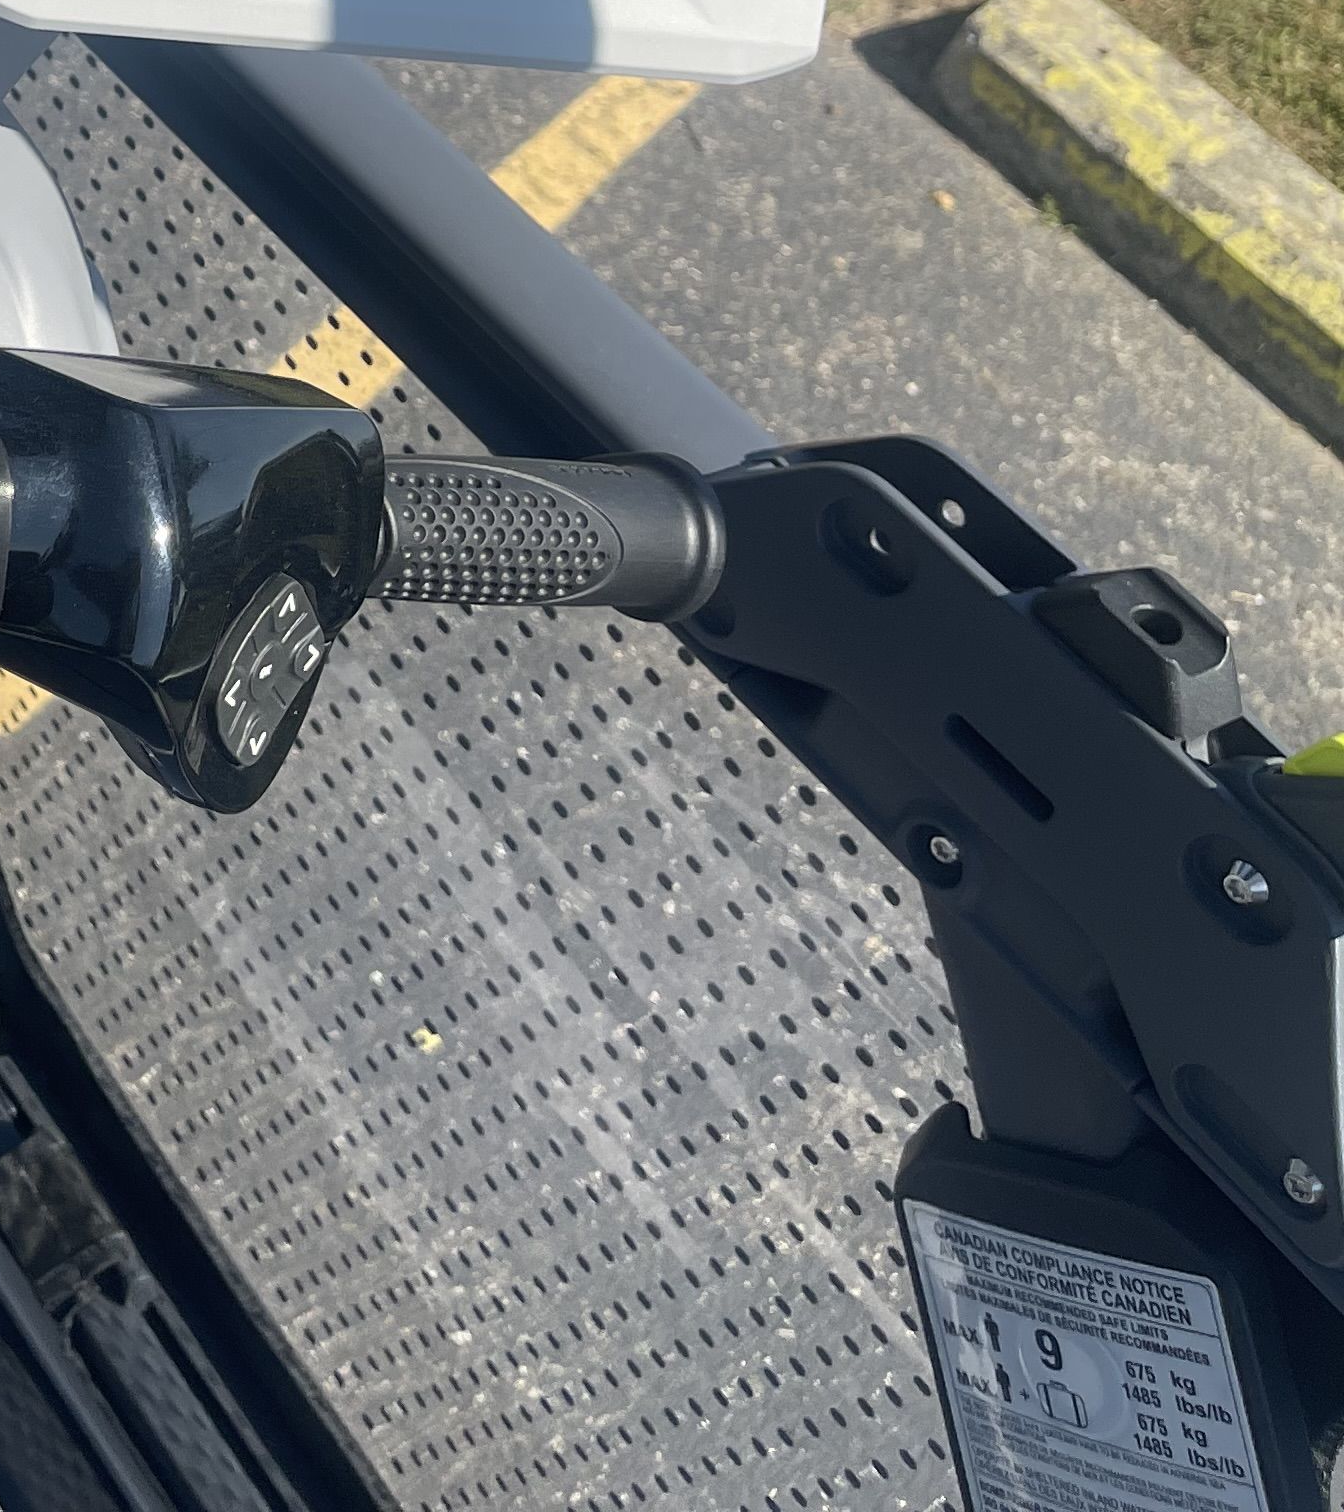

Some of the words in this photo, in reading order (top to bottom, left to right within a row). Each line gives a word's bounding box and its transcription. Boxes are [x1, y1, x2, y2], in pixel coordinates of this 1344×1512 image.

[934, 1220, 1009, 1260] CANADIAN
[1011, 1246, 1117, 1288] COMPLIANCE
[1119, 1273, 1186, 1305] NOTICE
[972, 1252, 993, 1274] DE
[995, 1260, 1099, 1304] CONFORMITÉ
[1101, 1289, 1192, 1326] CANADIEN
[1014, 1288, 1097, 1323] RECOMMENDED
[1098, 1313, 1129, 1332] SAFE
[1130, 1320, 1169, 1342] LIMITS
[1037, 1308, 1053, 1325] DE
[1110, 1330, 1211, 1367] RECOMMANDÉES
[1034, 1328, 1063, 1371] 9
[1125, 1360, 1156, 1385] 675
[1169, 1369, 1197, 1397] kg
[1121, 1382, 1162, 1409] 1485
[1174, 1394, 1233, 1425] lbs/lb
[1136, 1412, 1169, 1437] 675
[1181, 1421, 1208, 1448] kg
[1133, 1433, 1173, 1459] 1485
[1187, 1447, 1246, 1478] lbs/lb
